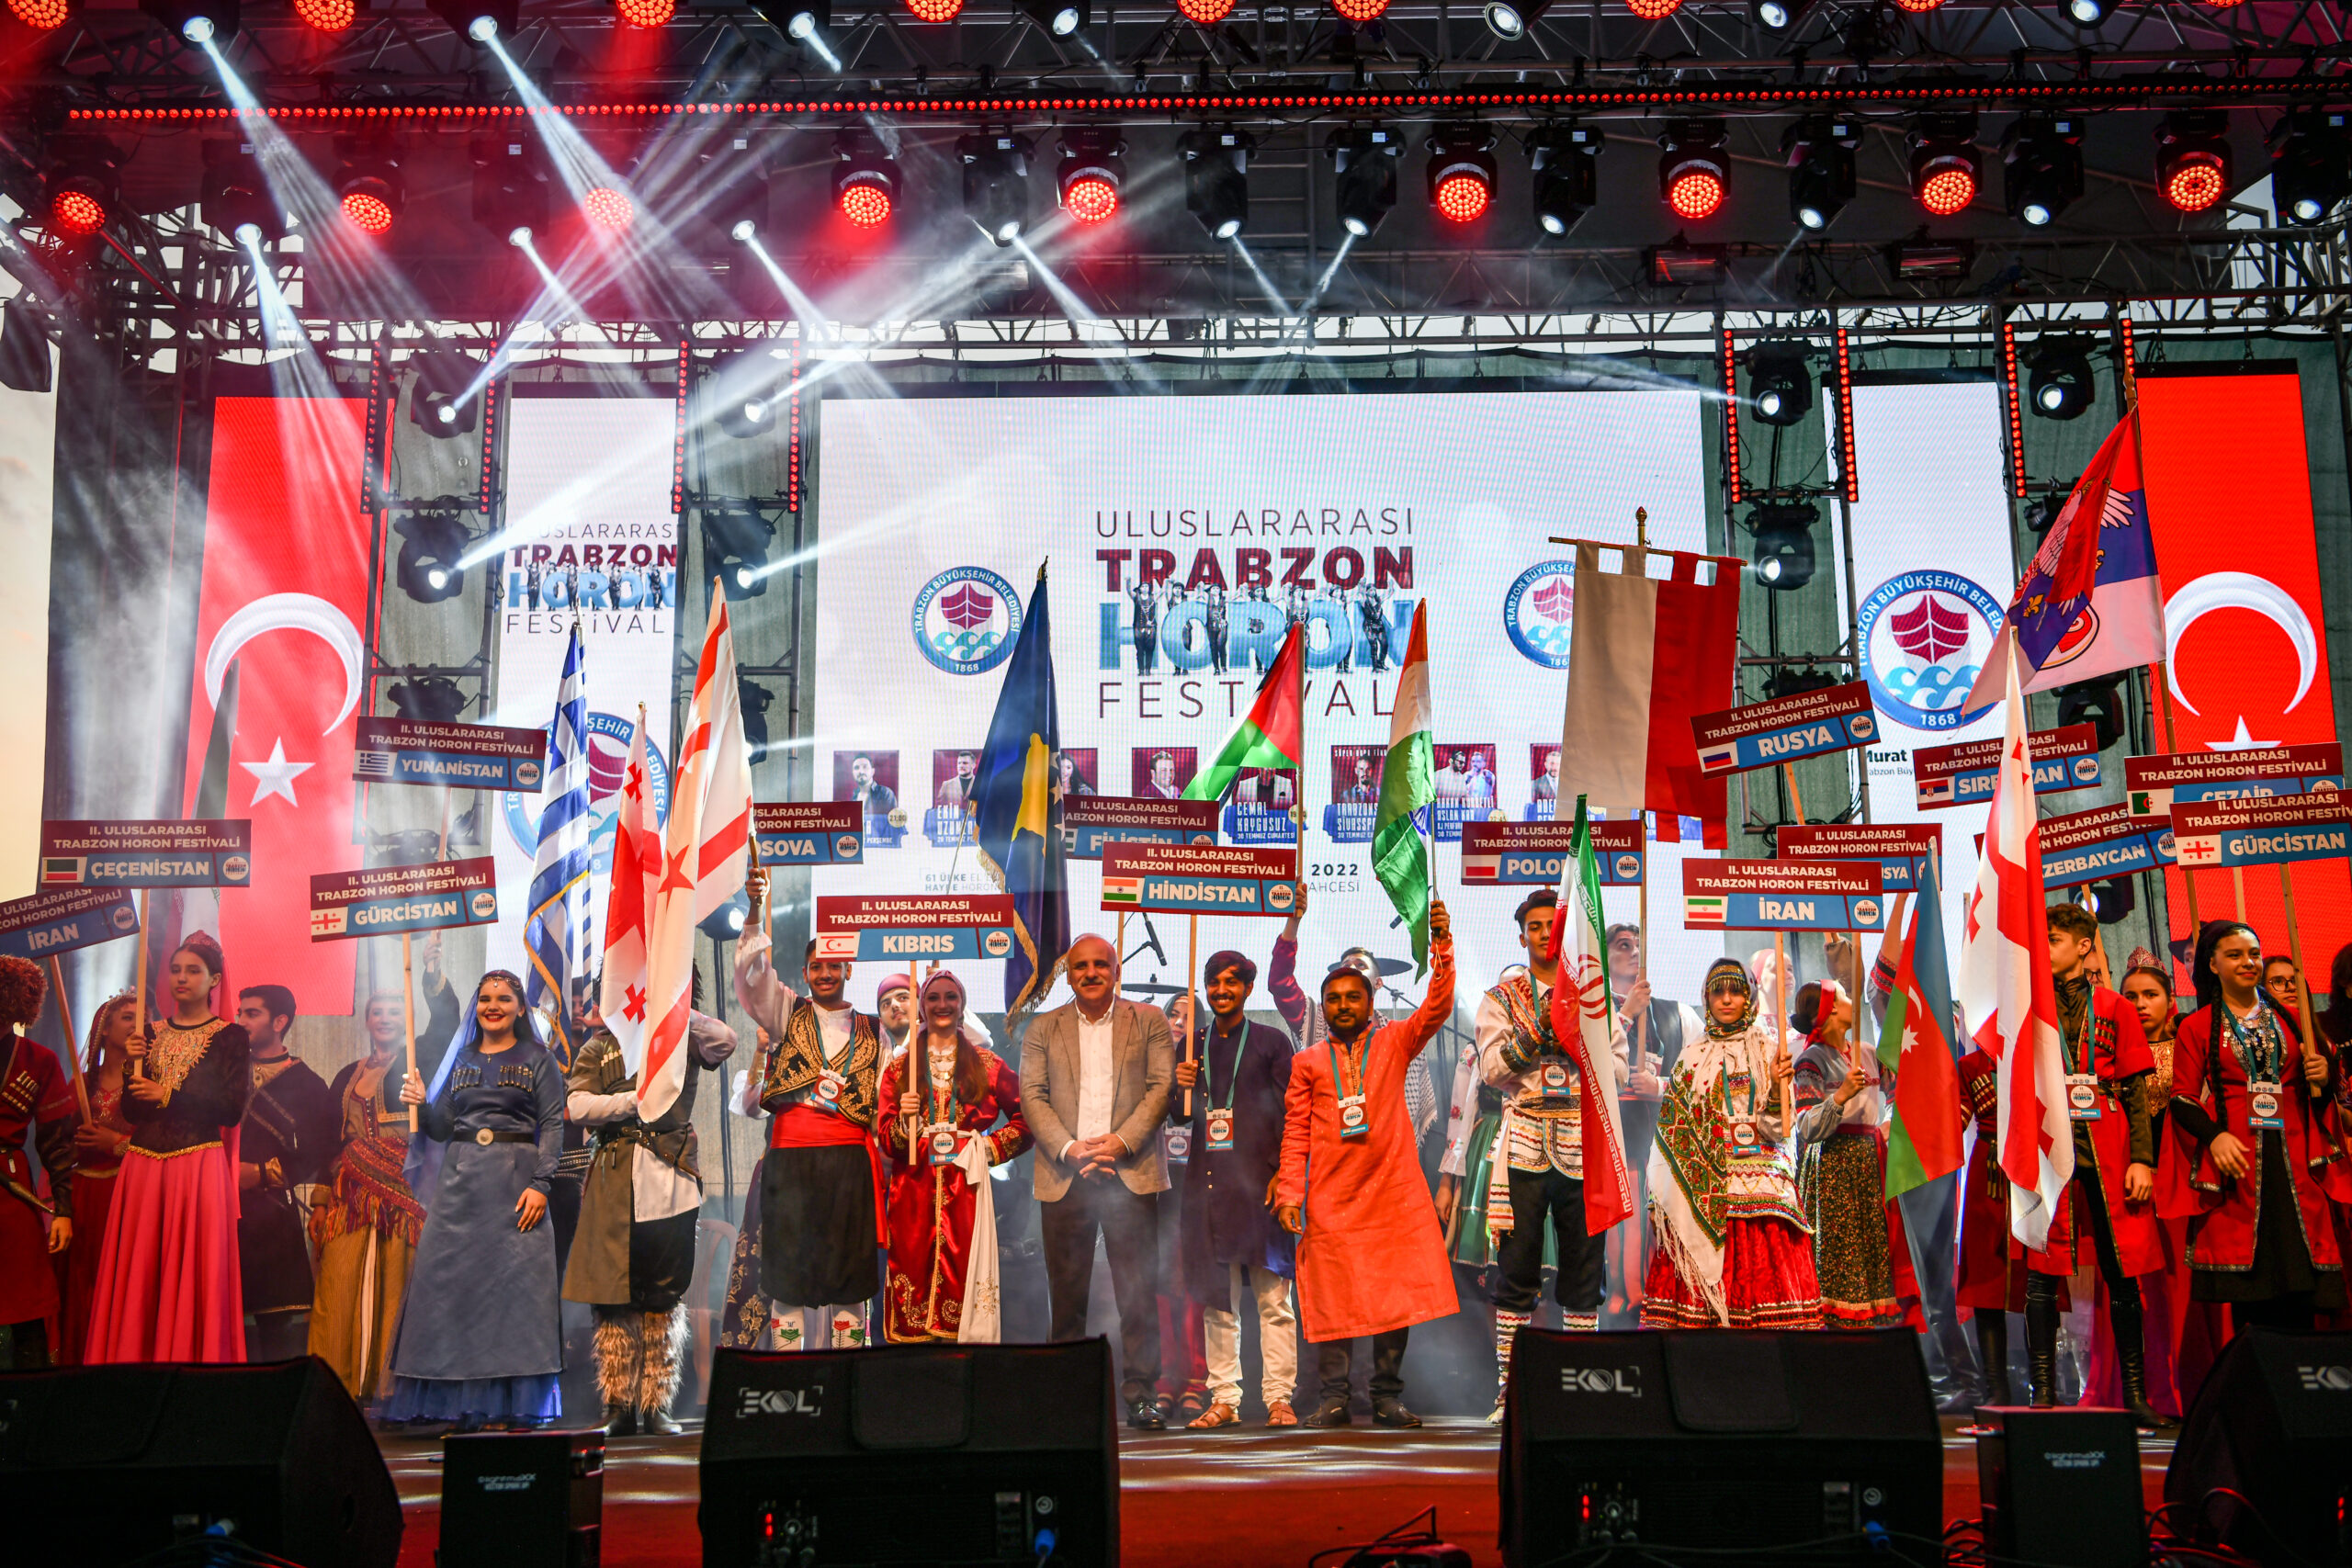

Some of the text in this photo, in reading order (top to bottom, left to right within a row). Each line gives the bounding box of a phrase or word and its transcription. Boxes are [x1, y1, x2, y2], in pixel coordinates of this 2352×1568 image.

[1097, 508, 1412, 537] ULUSLARARASI
[509, 544, 677, 567] TRABZON
[1096, 546, 1414, 592] TRABZON
[1508, 564, 1575, 626] TRABZON BÜYÜKŞEH
[1876, 575, 1969, 604] BÜYÜKŞEHİR
[914, 587, 935, 633] TRABZON
[933, 570, 994, 590] BÜYÜKŞEHİR
[1099, 600, 1414, 670] HORON
[956, 663, 978, 671] 1868
[1551, 658, 1569, 666] 186
[1099, 680, 1394, 718] FESTAL
[1731, 694, 1828, 721] II. ULUSLARARASI
[1705, 698, 1860, 739] TRABZON HORON FESTİVALİ
[1921, 714, 1956, 726] 1868
[401, 725, 504, 739] II. ULUSLARARASI
[369, 735, 534, 754] TRABZON HORON FESTİVALİ
[1758, 726, 1834, 758] RUSYA
[1966, 735, 2055, 755] ULUSLRASI
[1925, 759, 1981, 773] TRABZON
[2030, 740, 2088, 758] FESTİVALİ
[2173, 750, 2290, 766] II. ULUSLARARASI
[401, 760, 503, 778] YUNANİSTAN
[2140, 759, 2326, 781] TRABZON HORON FESTİVALİ
[1080, 801, 1178, 813] II. ULUSLARARASI
[1238, 802, 1268, 816] CEMAL
[1338, 803, 1377, 816] TRABZONS
[2218, 794, 2339, 810] II. ULUSLARARASI
[753, 808, 821, 817] USLARARASI
[1064, 813, 1206, 826] ABZON HORON FESTİVALİ
[2186, 805, 2352, 827] TRABZON HORON FESTİV
[105, 826, 207, 834] ULUSLARARASI
[795, 818, 851, 829] FESTİVALİ
[1238, 818, 1286, 831] KAYGUSUZ
[1338, 816, 1375, 830] SİVASSP
[1503, 826, 1601, 835] II. ULUSLARASI
[53, 836, 240, 848] TRABZON HORON FESTİVALİ
[1474, 837, 1631, 848] TRABZON HORON STİVALİ
[1815, 830, 1905, 840] II. ULUSLARARASI
[2053, 829, 2100, 847] HORON
[2230, 832, 2346, 855] GÜRCİSTAN
[749, 840, 816, 857] OSOVA
[1148, 849, 1254, 861] II. ULUSLARARASI
[1788, 840, 1928, 855] TRABZON HORON FESTİVAL
[92, 858, 209, 879] ÇEÇENİSTAN
[1114, 860, 1285, 874] TRABZON HORON FESTİVALİ
[1311, 863, 1358, 875] 2022
[1728, 866, 1837, 876] II. ULUSLARARASI
[348, 866, 455, 886] II. ULUSLARARASI
[1697, 878, 1869, 890] TRABZON HORON FESTİVALİ
[316, 874, 486, 901] TRABZON HORON FESTİVALİ
[1149, 880, 1255, 903] HİNDİSTAN
[1308, 880, 1360, 892] AHÇESİ
[355, 900, 457, 925] GÜRCİSTAN
[862, 901, 969, 910] II. ULUSLARARASI
[1758, 897, 1815, 920] İRAN
[22, 905, 65, 924] HORON
[830, 911, 1001, 924] TRABZON HORON FESTİVALİ
[27, 923, 79, 951] İRAN
[883, 936, 954, 953] KIBRIS
[1561, 1369, 1634, 1392] EKOL
[2298, 1366, 2352, 1389] EKO
[743, 1390, 814, 1413] EKOL
